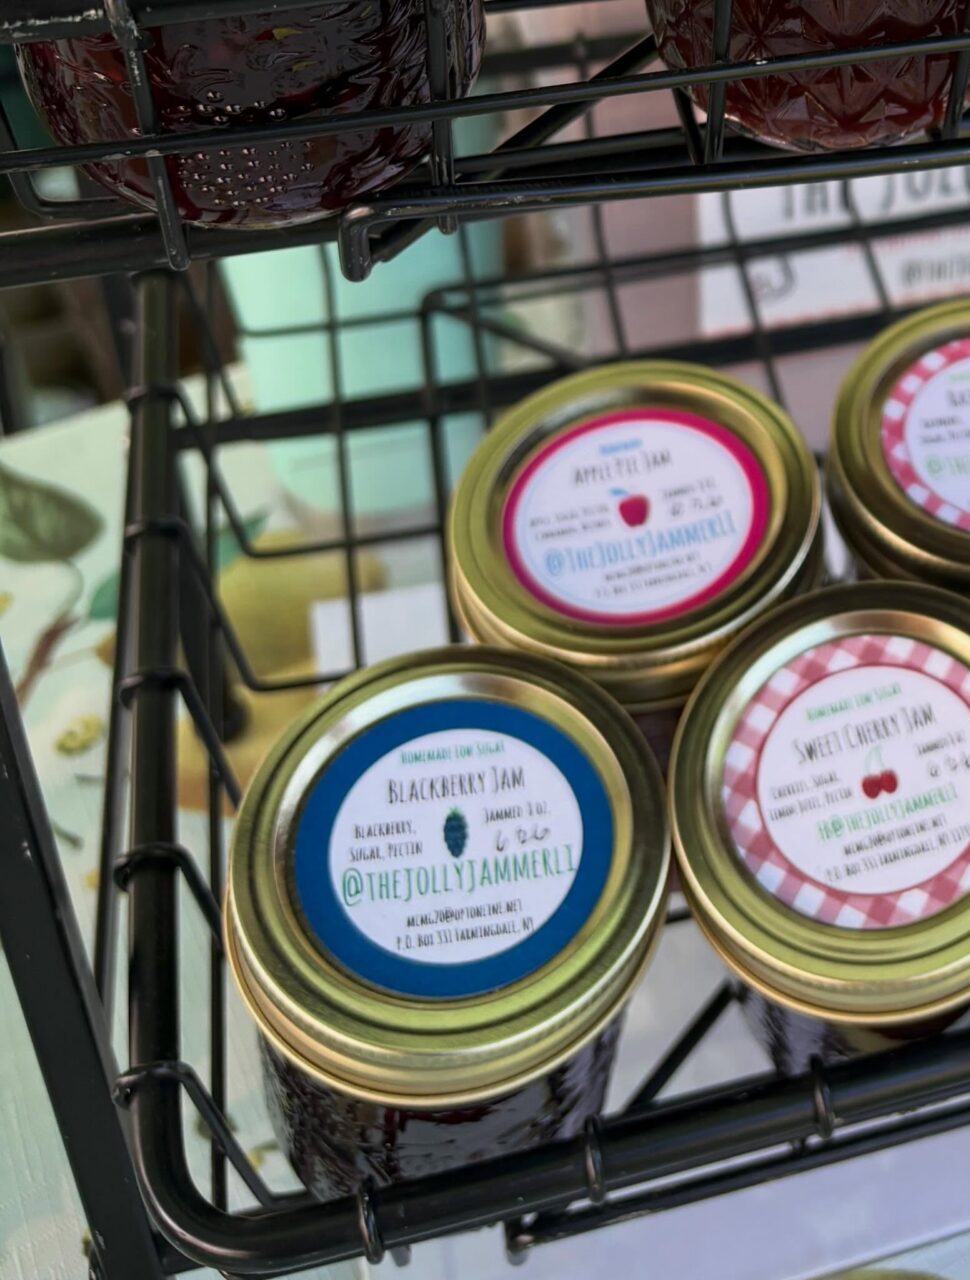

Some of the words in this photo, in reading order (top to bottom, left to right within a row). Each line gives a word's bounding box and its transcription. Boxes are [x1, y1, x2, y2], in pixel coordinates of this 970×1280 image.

[640, 449, 673, 470] JAM
[792, 728, 844, 766] SWEET
[843, 711, 900, 749] CHERRY
[899, 702, 937, 734] JAM
[387, 770, 487, 804] BLACKBERRY
[491, 766, 525, 794] JAM
[483, 805, 521, 824] JAMMED
[354, 820, 416, 840] BLACKBERRY,
[349, 845, 386, 863] SUGAR,
[387, 841, 422, 858] PECTIN
[342, 843, 576, 907] @THEJOLLYJAMMERLI
